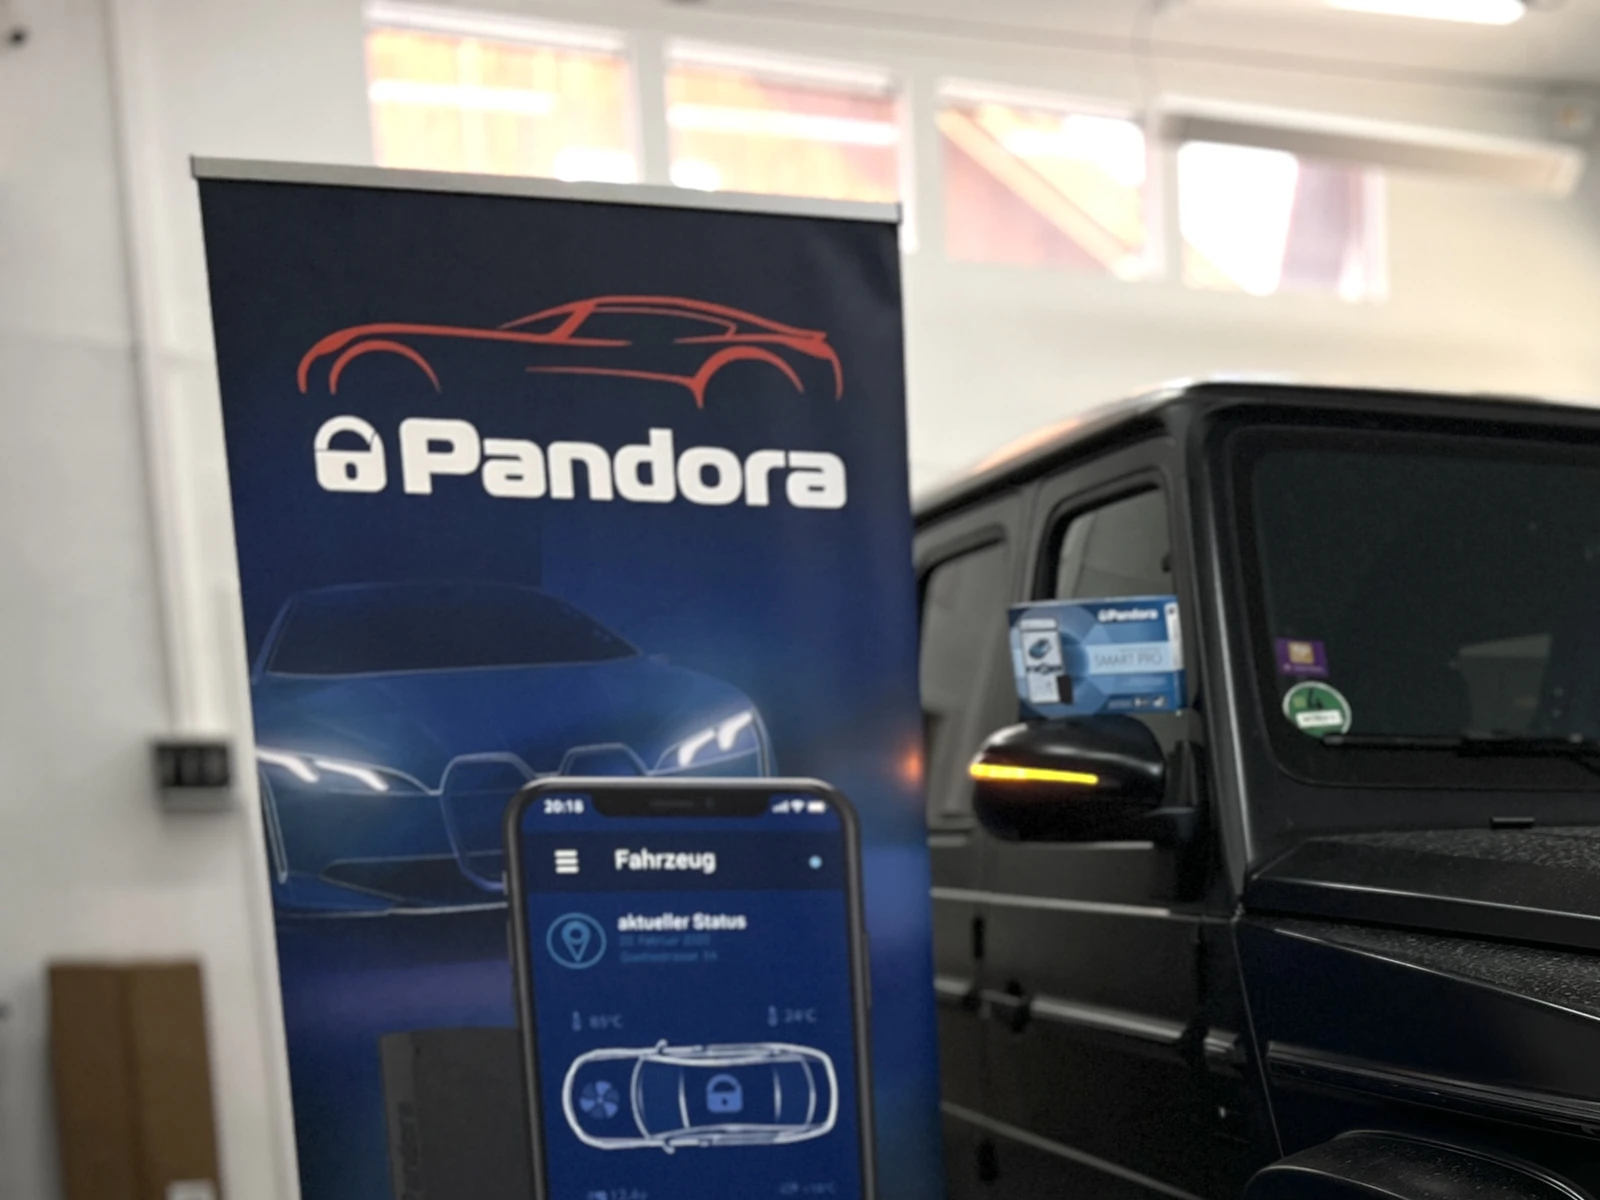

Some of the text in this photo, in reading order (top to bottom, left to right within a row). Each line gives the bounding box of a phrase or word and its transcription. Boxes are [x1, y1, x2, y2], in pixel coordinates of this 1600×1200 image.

[398, 416, 848, 510] Pandora
[613, 846, 717, 875] Fahrzeug
[617, 910, 748, 931] aktueller Status
